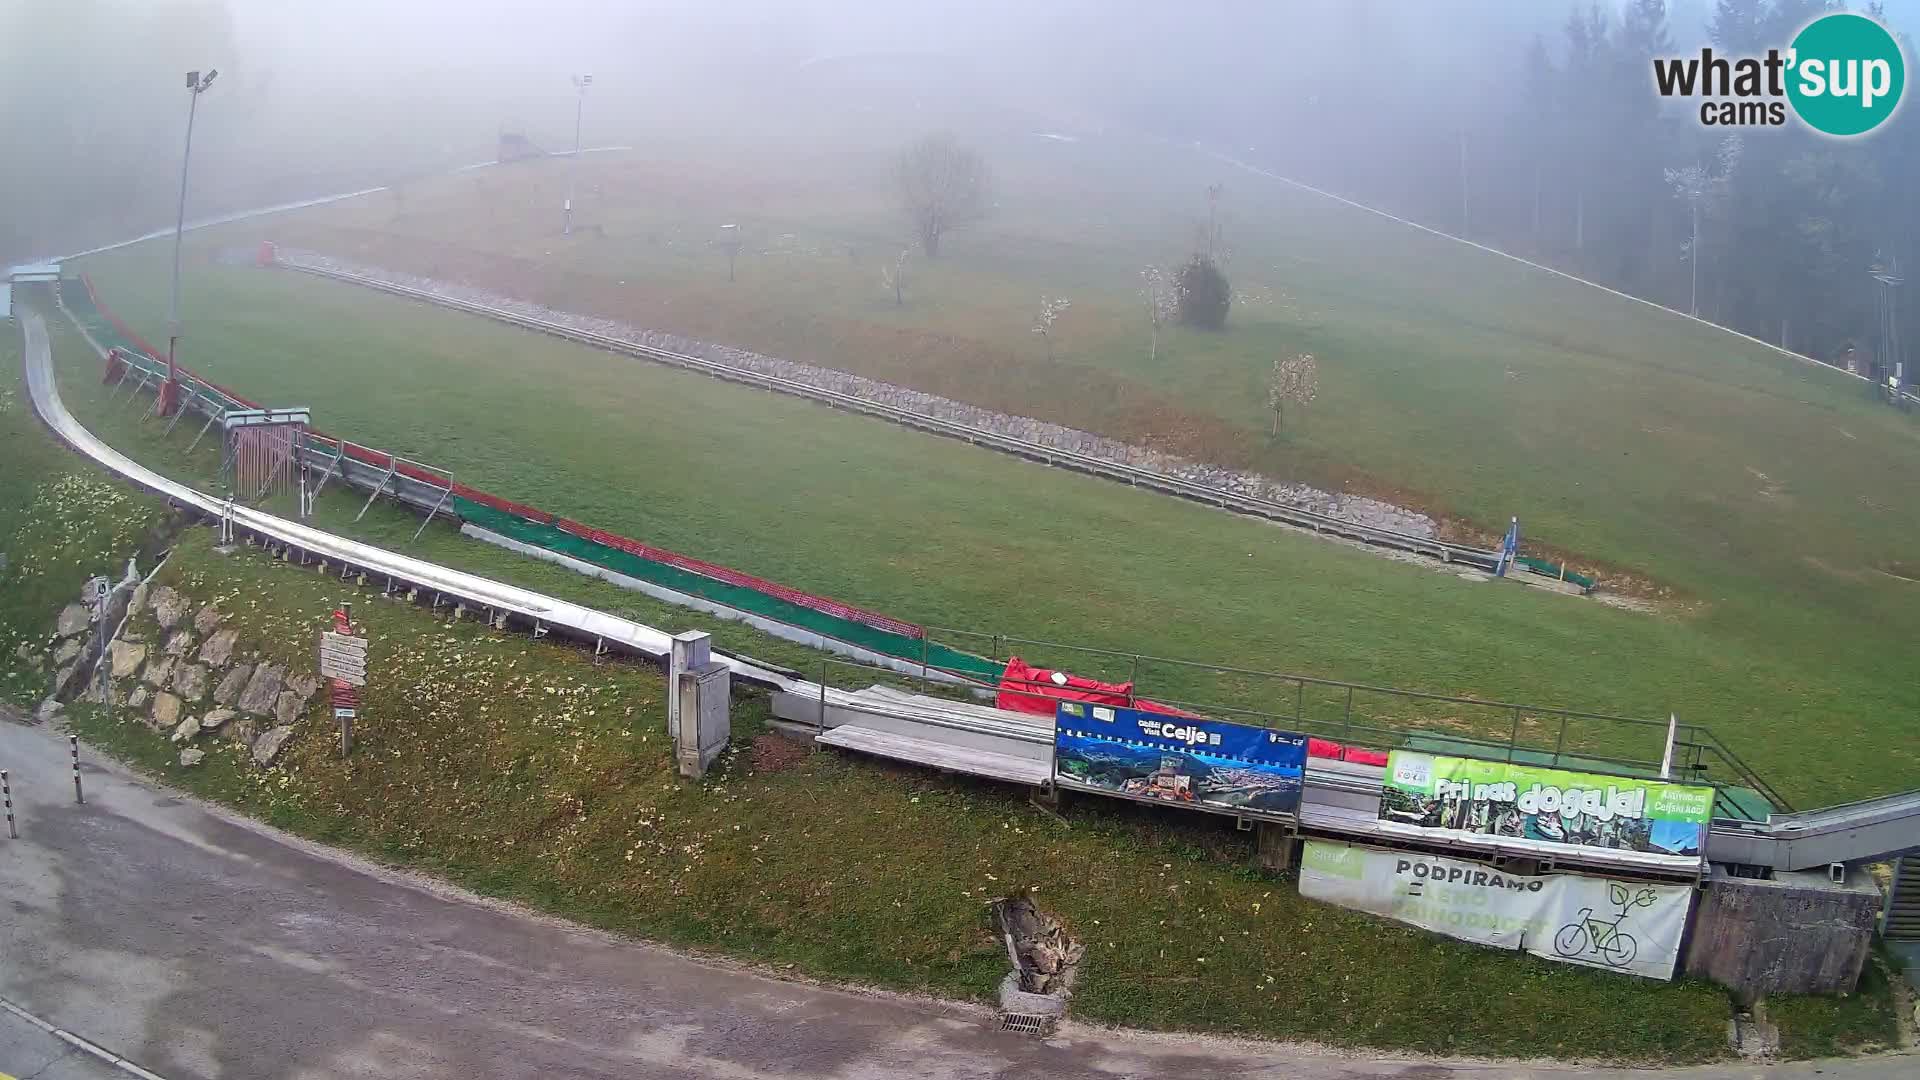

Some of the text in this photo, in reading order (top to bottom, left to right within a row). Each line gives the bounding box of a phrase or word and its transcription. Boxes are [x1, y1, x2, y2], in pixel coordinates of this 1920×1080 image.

[1161, 723, 1207, 745] Celje
[1434, 778, 1471, 801] Pri
[1473, 781, 1517, 802] nas
[1396, 859, 1544, 893] PODPIRAMO
